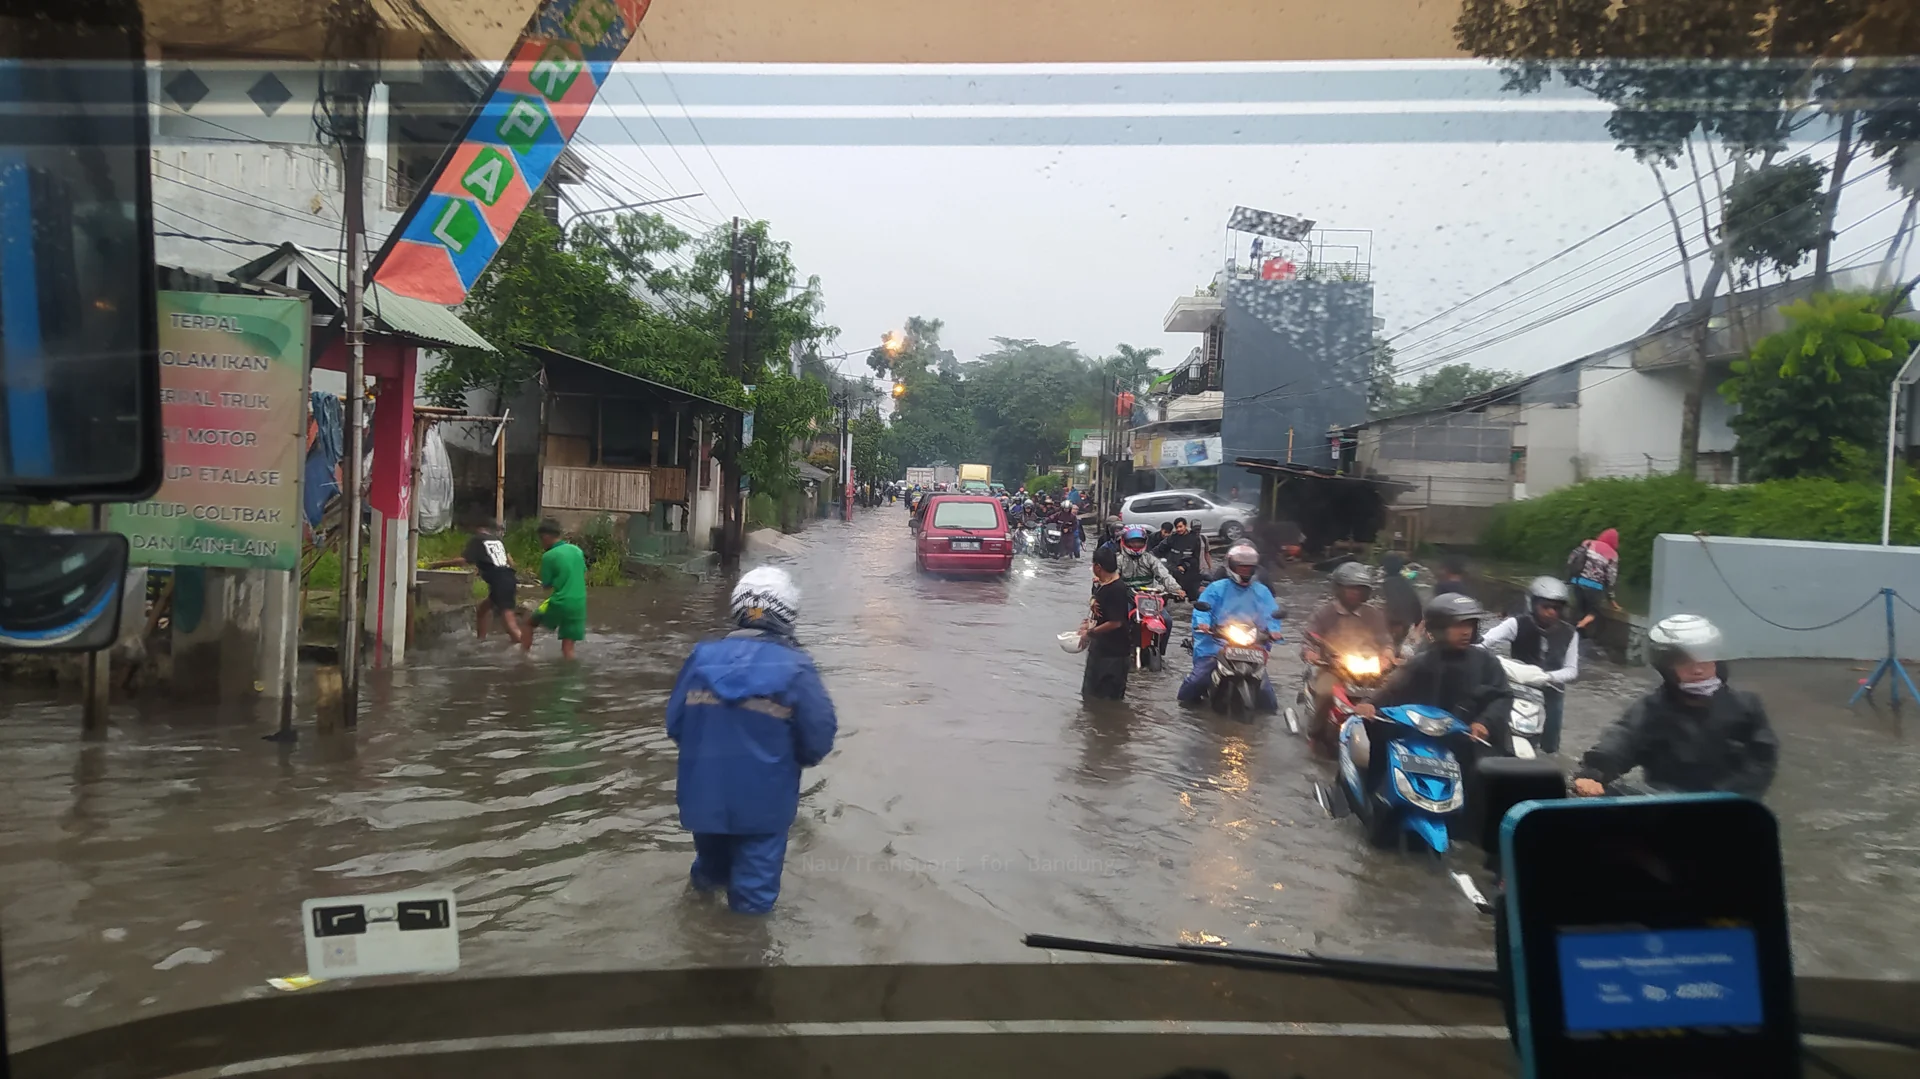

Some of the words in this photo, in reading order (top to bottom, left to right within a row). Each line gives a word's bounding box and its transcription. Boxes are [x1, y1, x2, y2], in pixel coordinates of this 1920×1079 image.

[171, 313, 243, 333] TERPAL
[159, 350, 217, 368] OLAM
[222, 354, 270, 371] IKAN
[160, 387, 215, 407] ERPAL
[220, 392, 270, 410] TRUK
[187, 428, 257, 446] MOTOR
[165, 465, 192, 481] UP
[199, 467, 280, 486] ETALASE
[127, 501, 187, 518] TUTUP
[192, 503, 281, 523] COLTBAK
[133, 534, 175, 550] DAN
[180, 536, 277, 556] LAIN-LAIN
